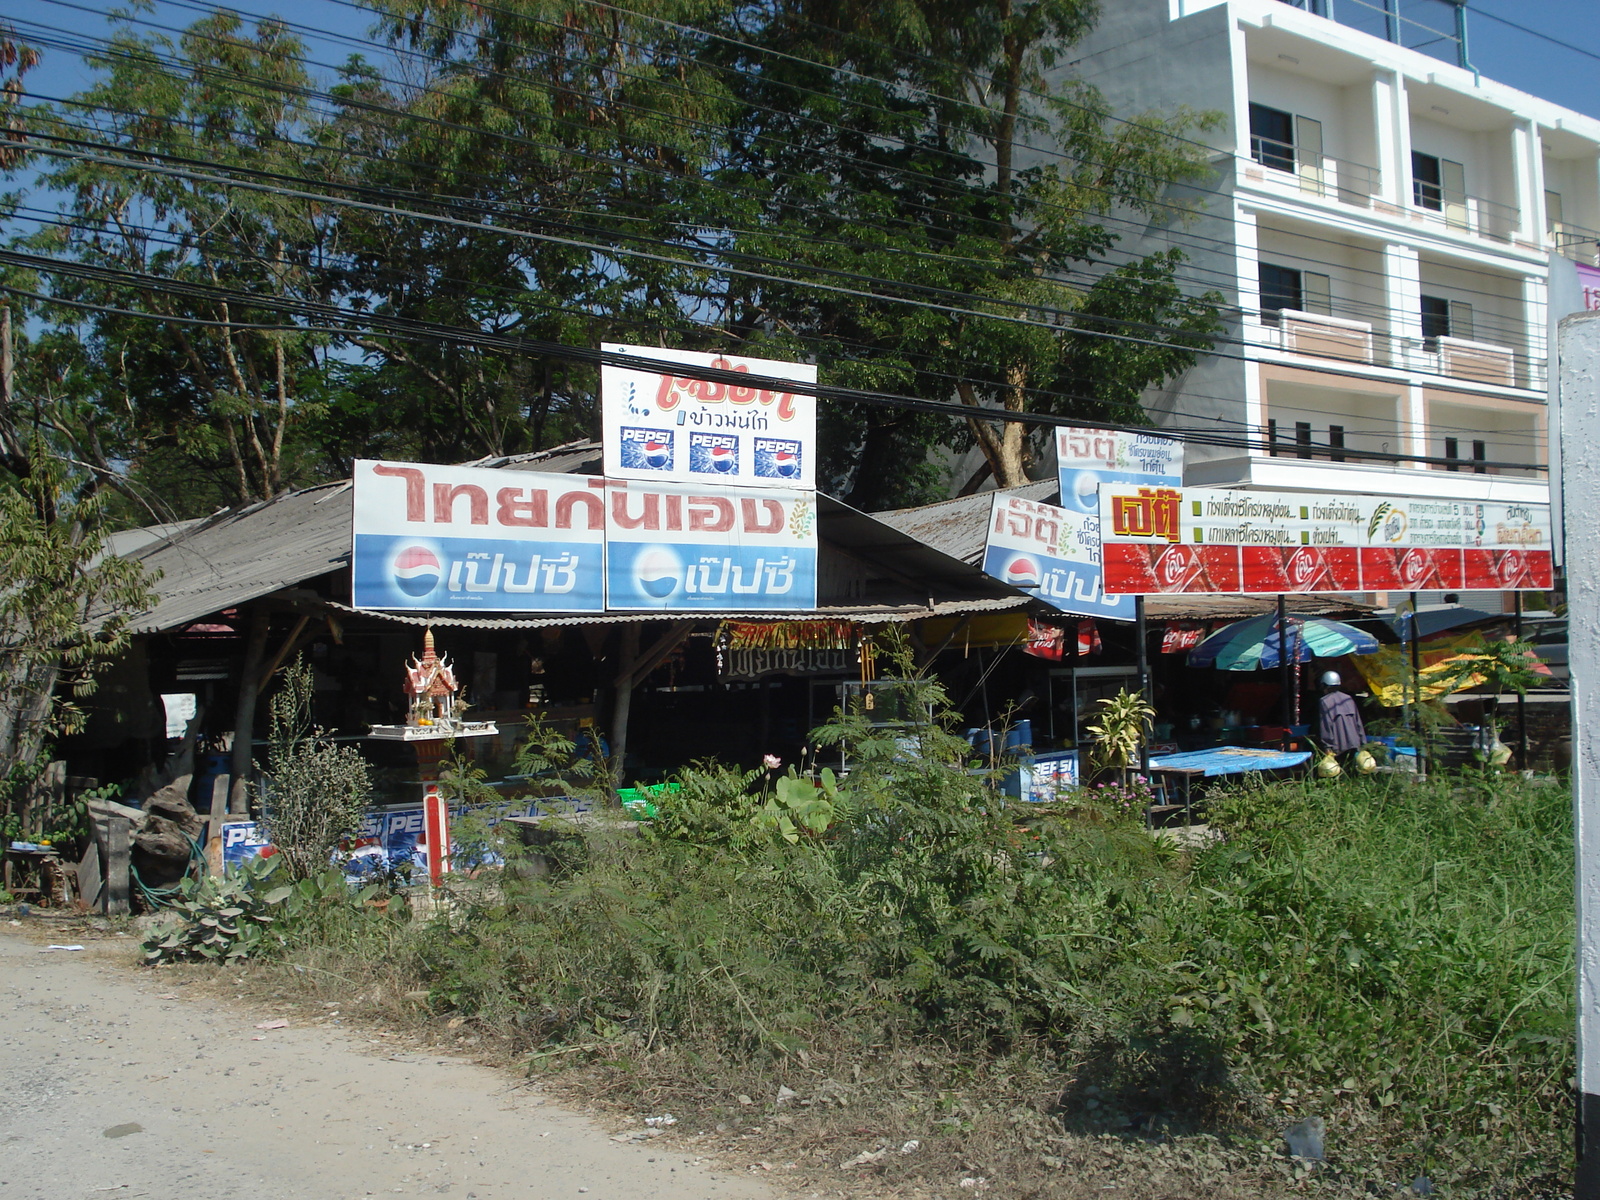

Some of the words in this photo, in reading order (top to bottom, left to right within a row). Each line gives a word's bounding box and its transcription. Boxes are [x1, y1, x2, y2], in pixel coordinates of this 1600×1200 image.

[622, 429, 671, 445] PEPSI
[691, 435, 736, 450] PEPSI
[755, 440, 799, 455] PEPSI
[372, 463, 785, 534] ไทยกันเอง
[448, 552, 579, 594] เป๊ปซี่
[684, 555, 797, 595] เป๊ปซี่
[1040, 567, 1121, 607] เป๊ป
